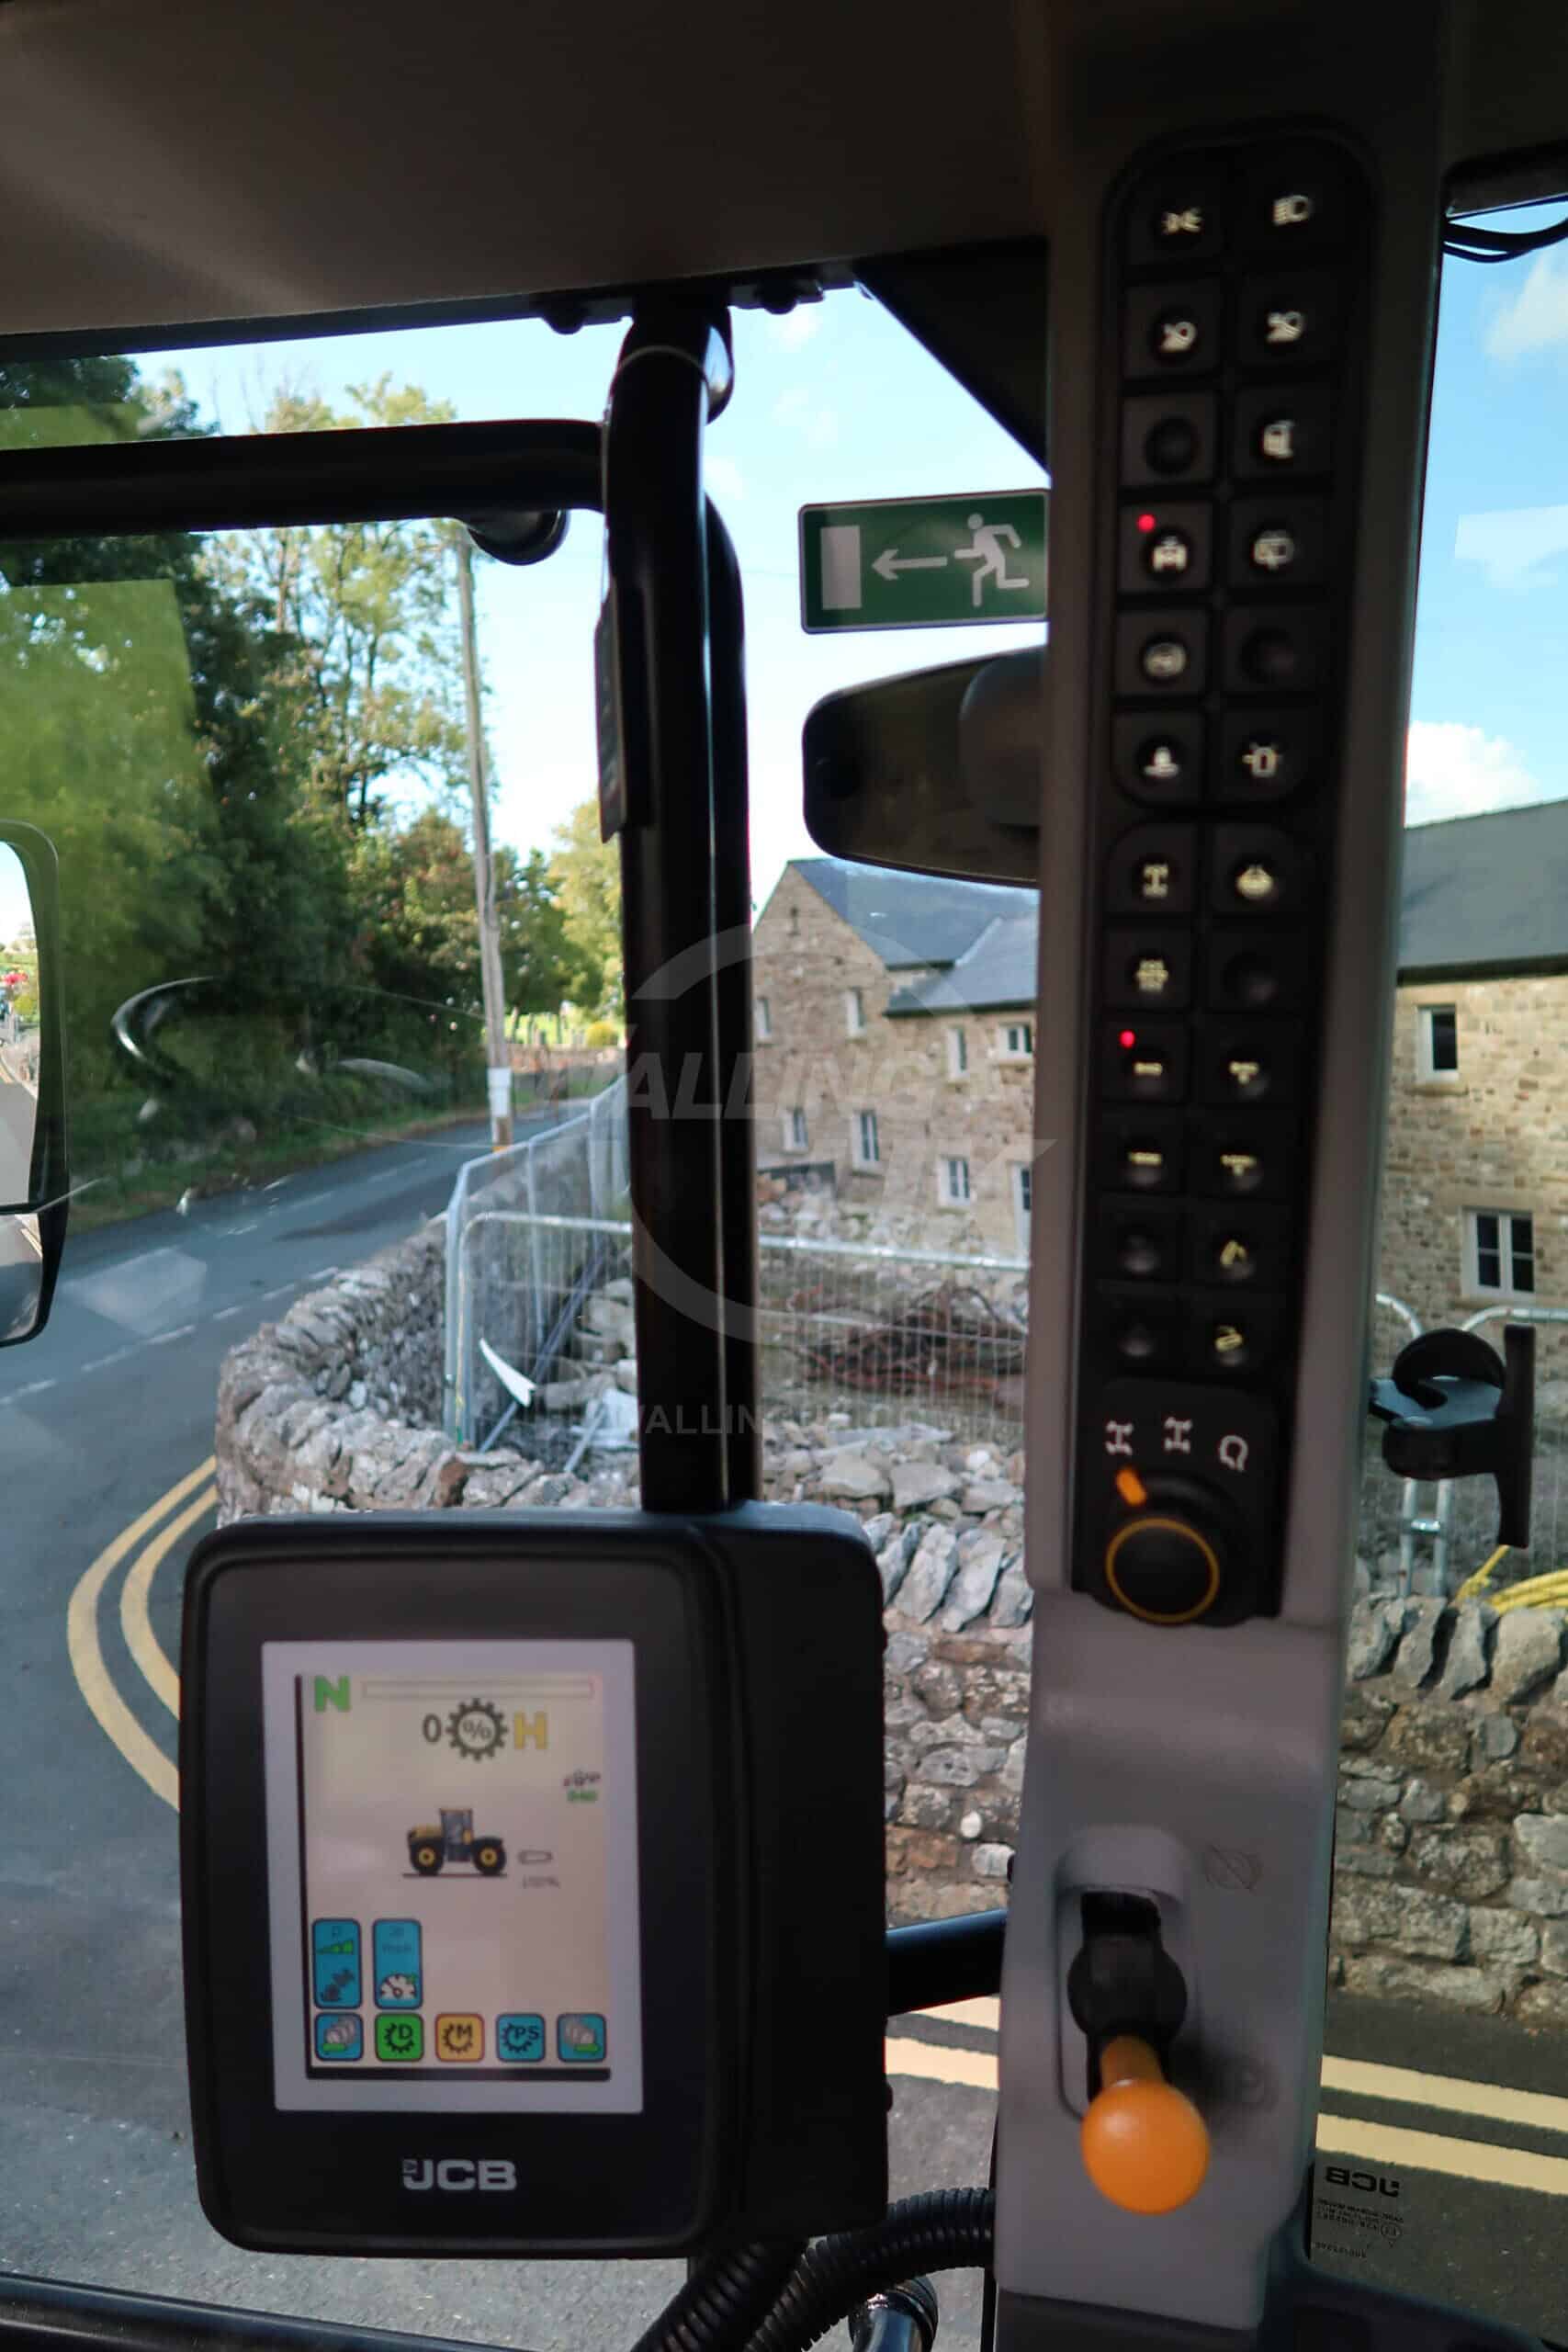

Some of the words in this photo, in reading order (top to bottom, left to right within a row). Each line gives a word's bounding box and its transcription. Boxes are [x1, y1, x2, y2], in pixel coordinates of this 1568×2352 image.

[313, 1675, 351, 1713] N
[513, 1712, 548, 1749] H
[399, 2024, 413, 2040] D
[514, 2025, 540, 2041] PS
[402, 2159, 517, 2191] JCB
